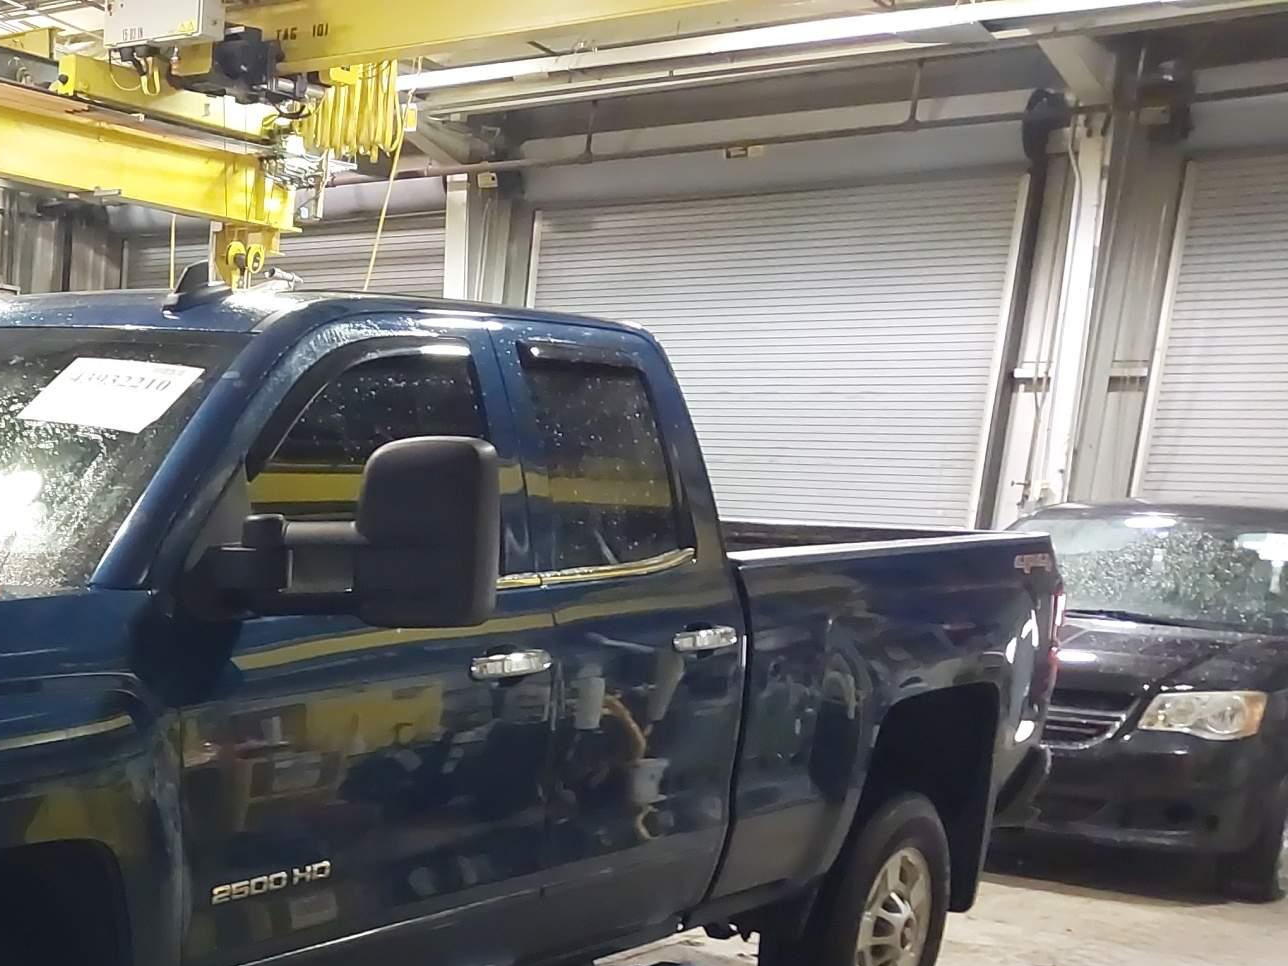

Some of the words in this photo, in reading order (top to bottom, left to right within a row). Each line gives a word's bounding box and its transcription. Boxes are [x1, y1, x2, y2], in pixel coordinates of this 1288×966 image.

[276, 27, 297, 40] TAG
[312, 23, 328, 38] 101
[211, 871, 287, 905] 2500
[292, 860, 331, 885] HD
